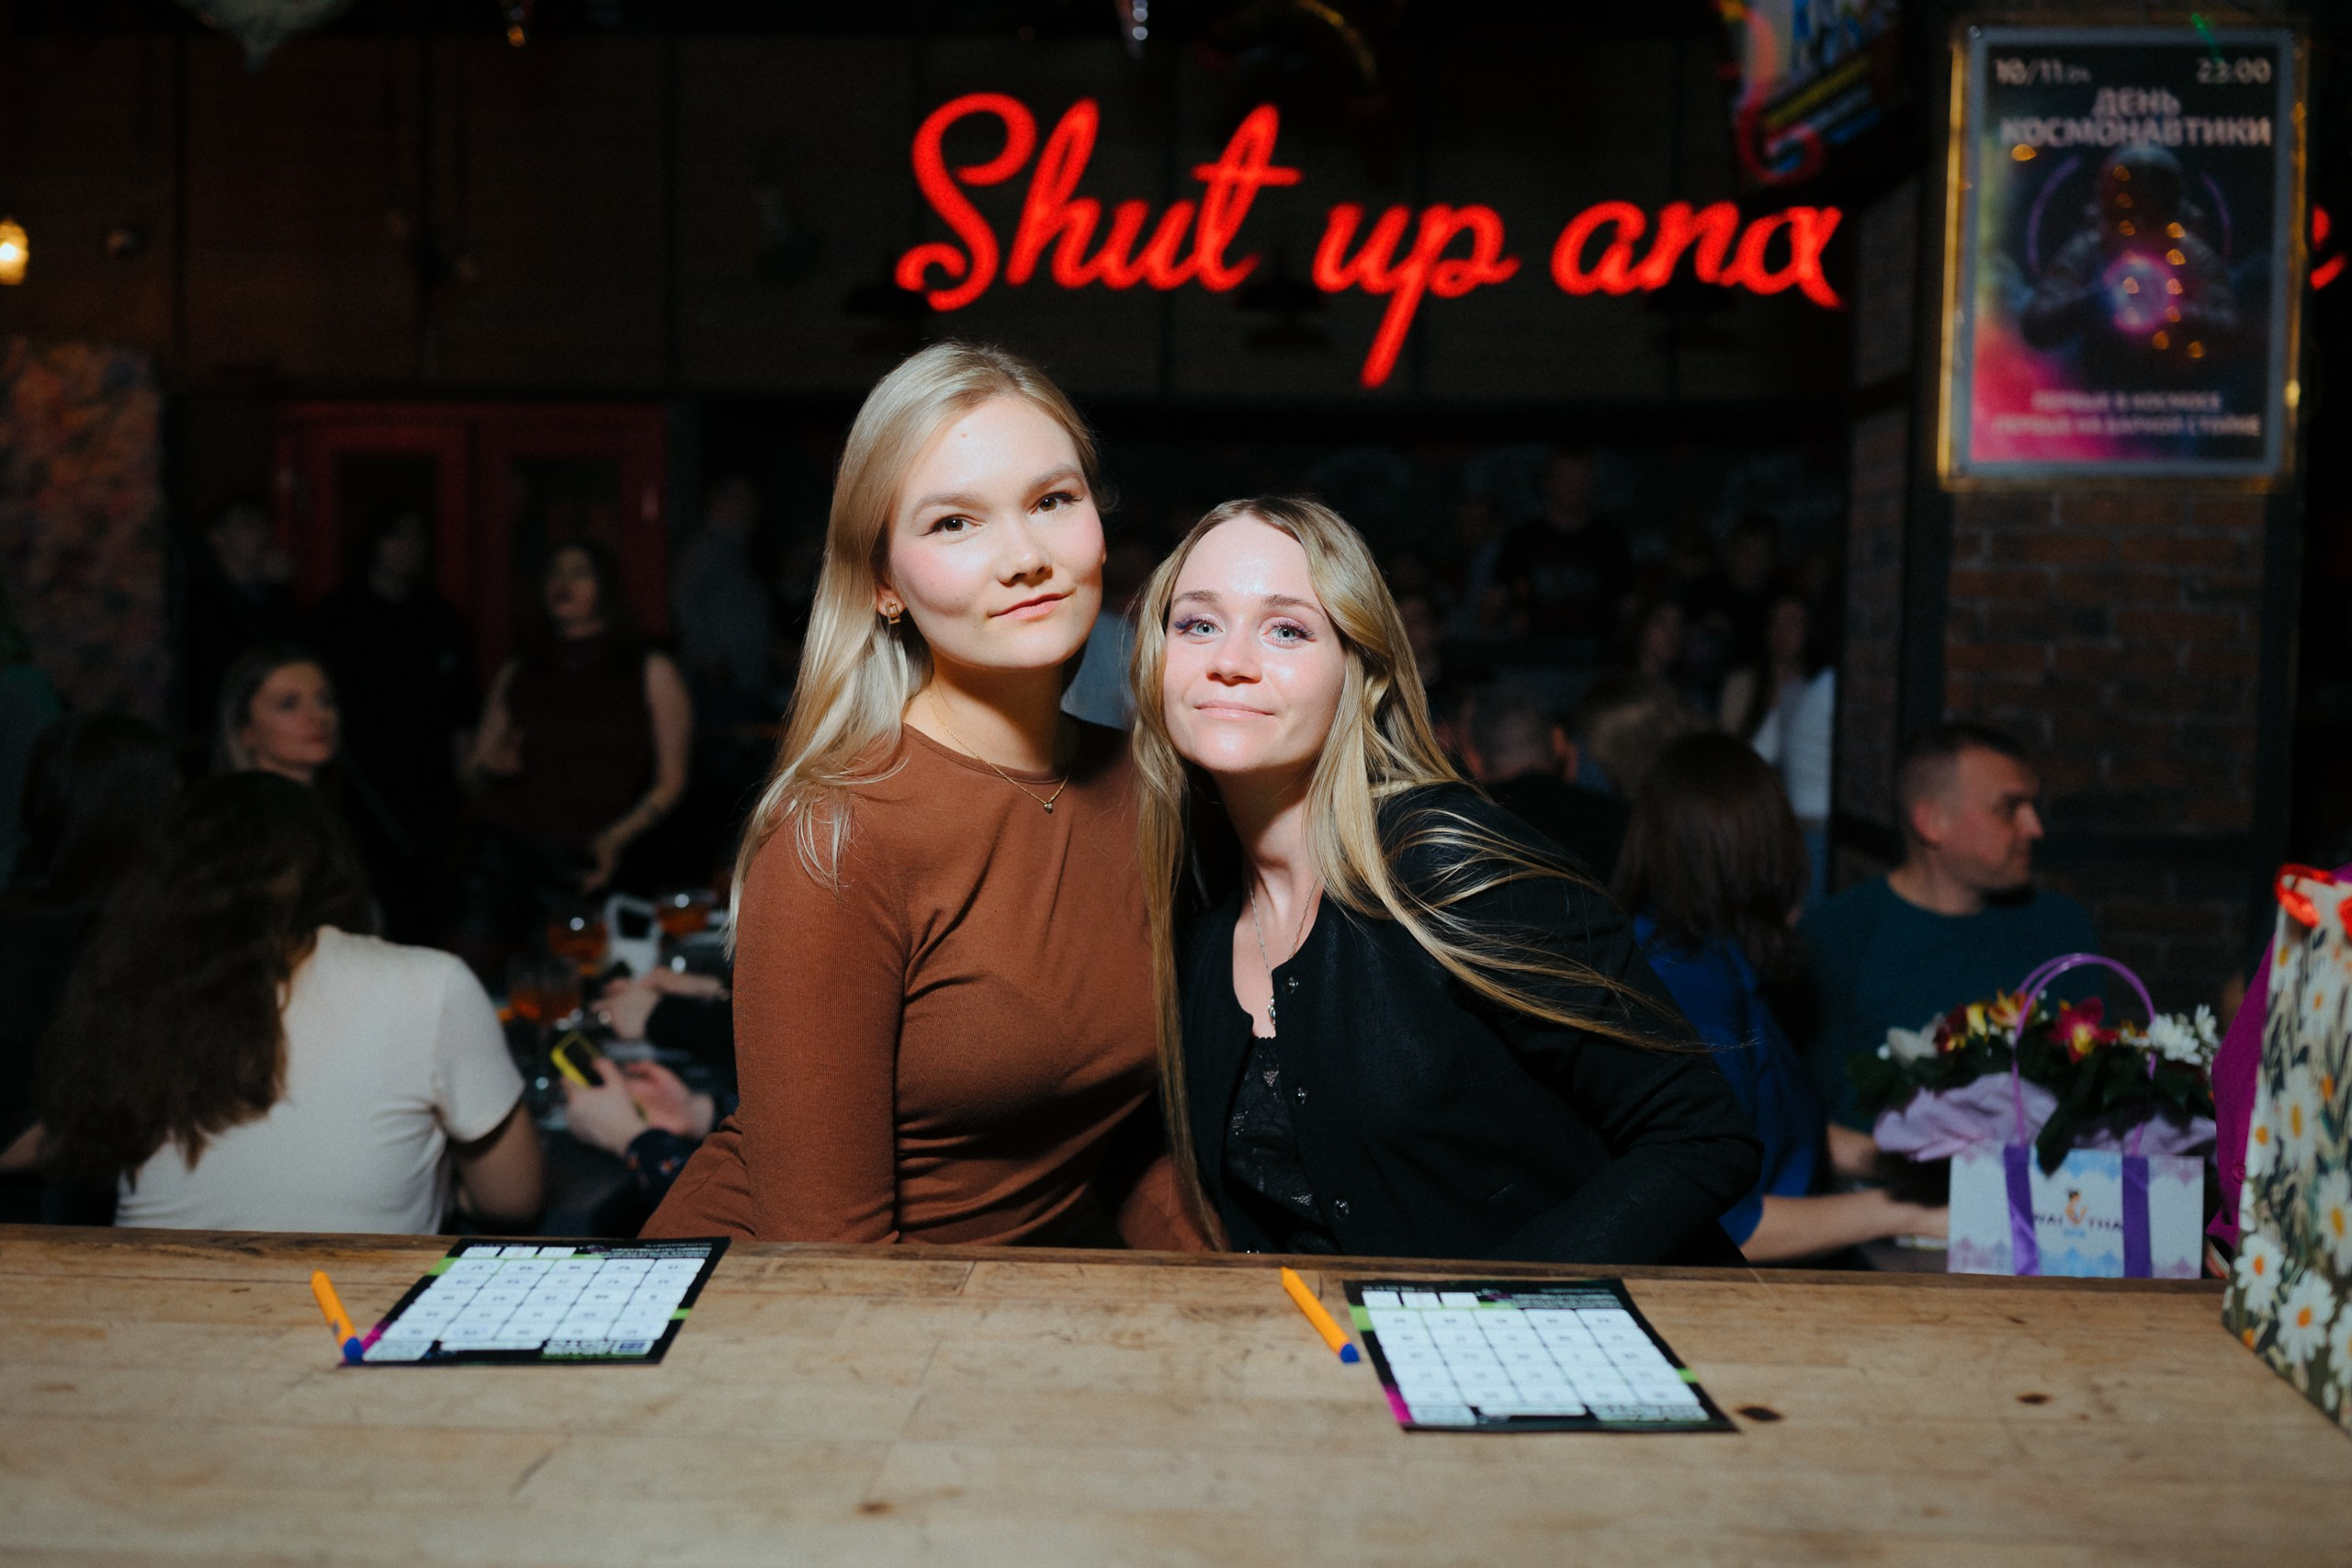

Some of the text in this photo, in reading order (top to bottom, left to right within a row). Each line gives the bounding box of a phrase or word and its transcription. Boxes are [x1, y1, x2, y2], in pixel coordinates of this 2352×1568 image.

[2091, 87, 2182, 118] ДЕНЬ
[2000, 117, 2272, 146] КОСМОНАВТИКИ
[897, 94, 1299, 310] Shut
[1313, 205, 1518, 386] up
